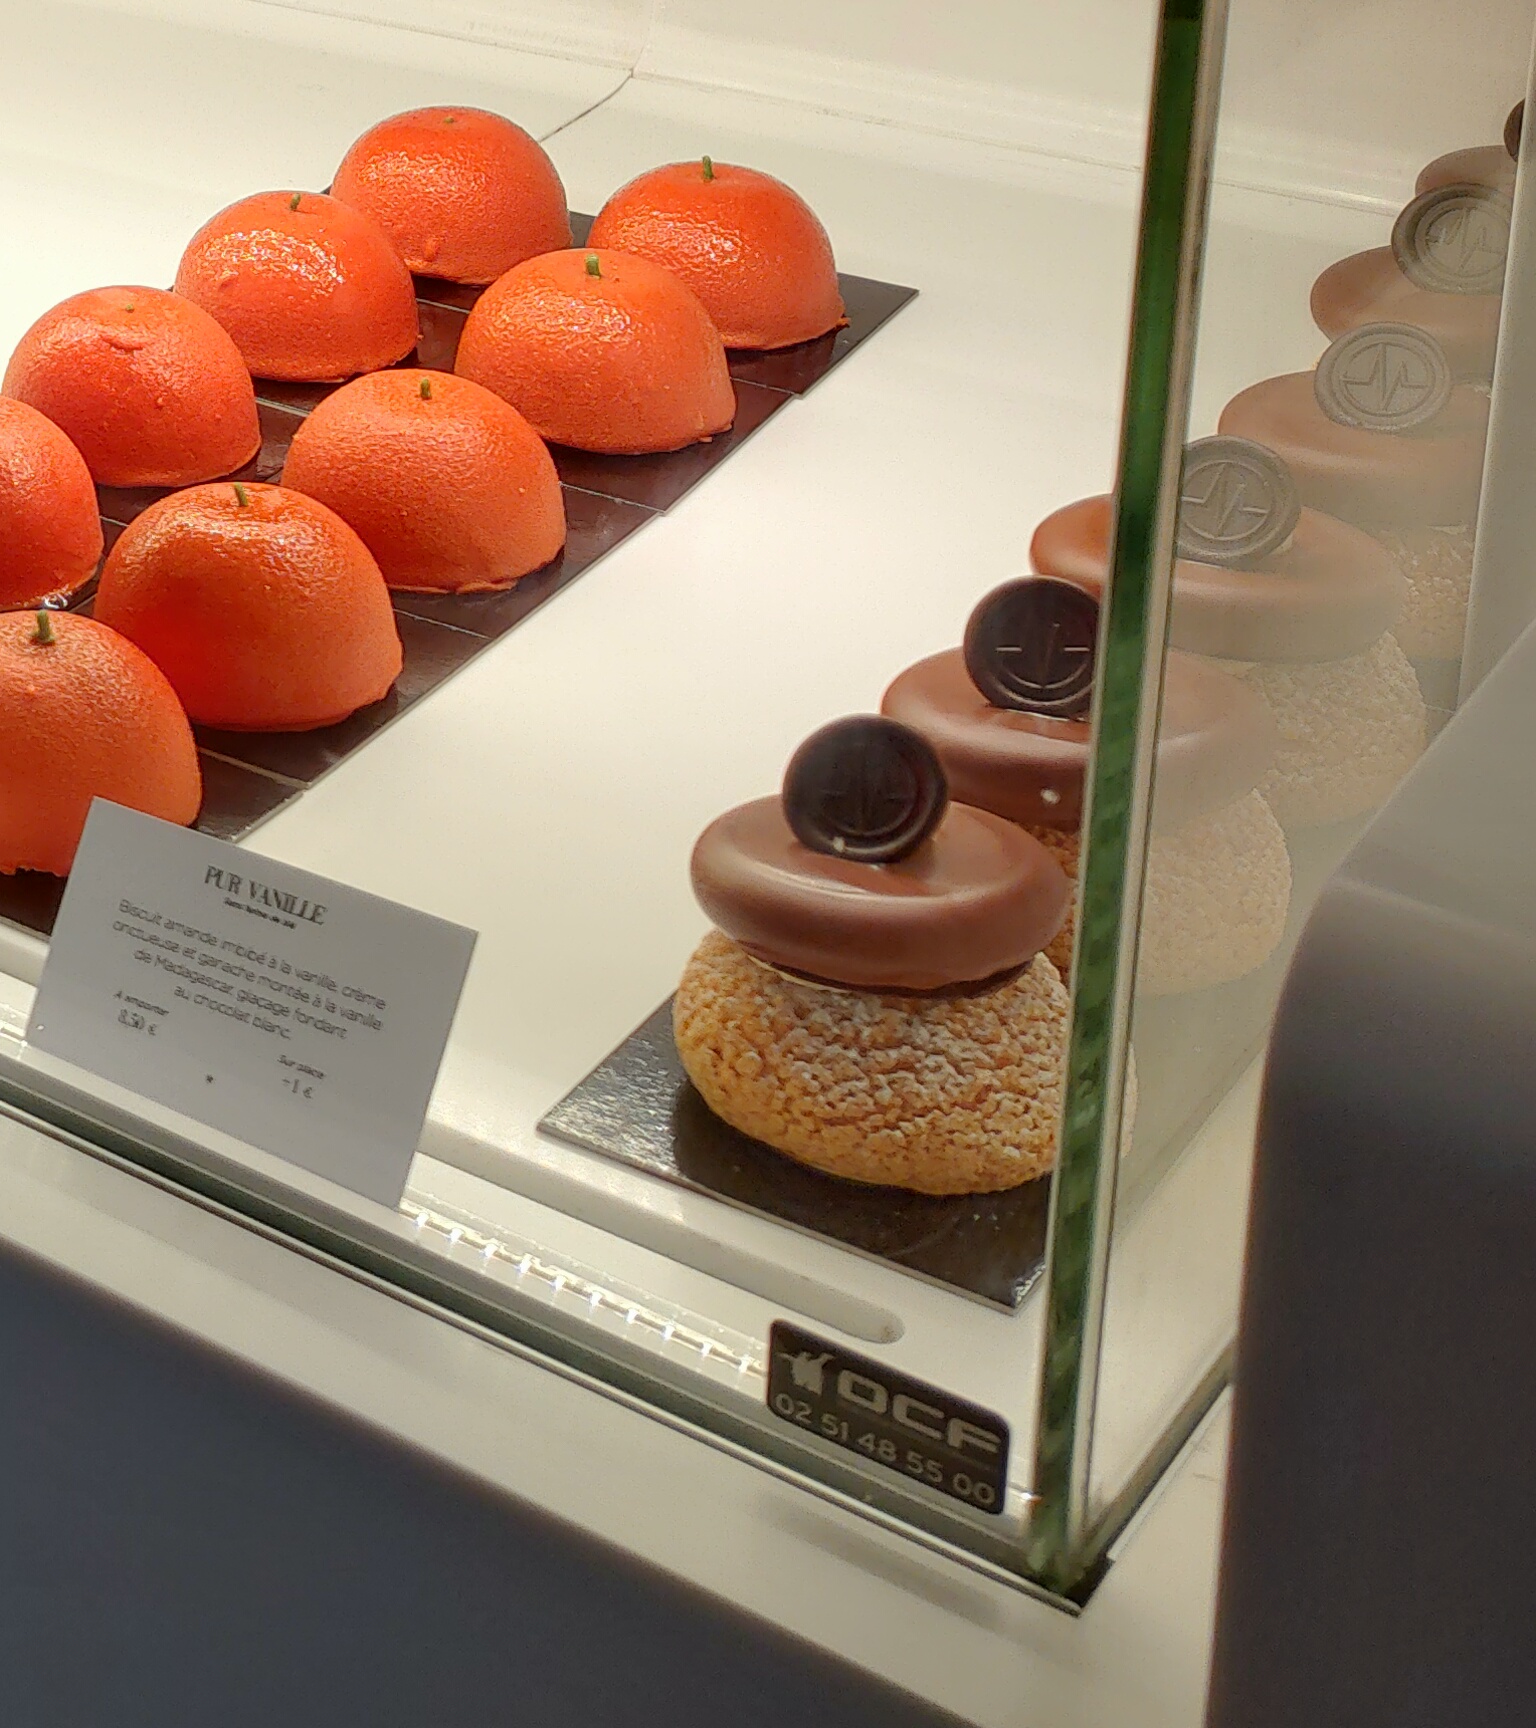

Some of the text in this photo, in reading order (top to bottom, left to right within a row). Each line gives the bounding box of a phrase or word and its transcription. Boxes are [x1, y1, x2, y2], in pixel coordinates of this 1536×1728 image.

[203, 864, 326, 925] PUR VANILLE
[111, 920, 382, 1031] onctueuse et ganache montée à la vanille
[118, 898, 162, 926] Biscuit
[162, 918, 218, 947] amande
[278, 959, 292, 975] la
[340, 985, 386, 1010] crème
[132, 948, 152, 964] de
[293, 1007, 347, 1039] fondant
[173, 984, 189, 1001] au
[192, 993, 251, 1024] chocolat
[773, 1393, 996, 1507] 02 51 48 55 00
